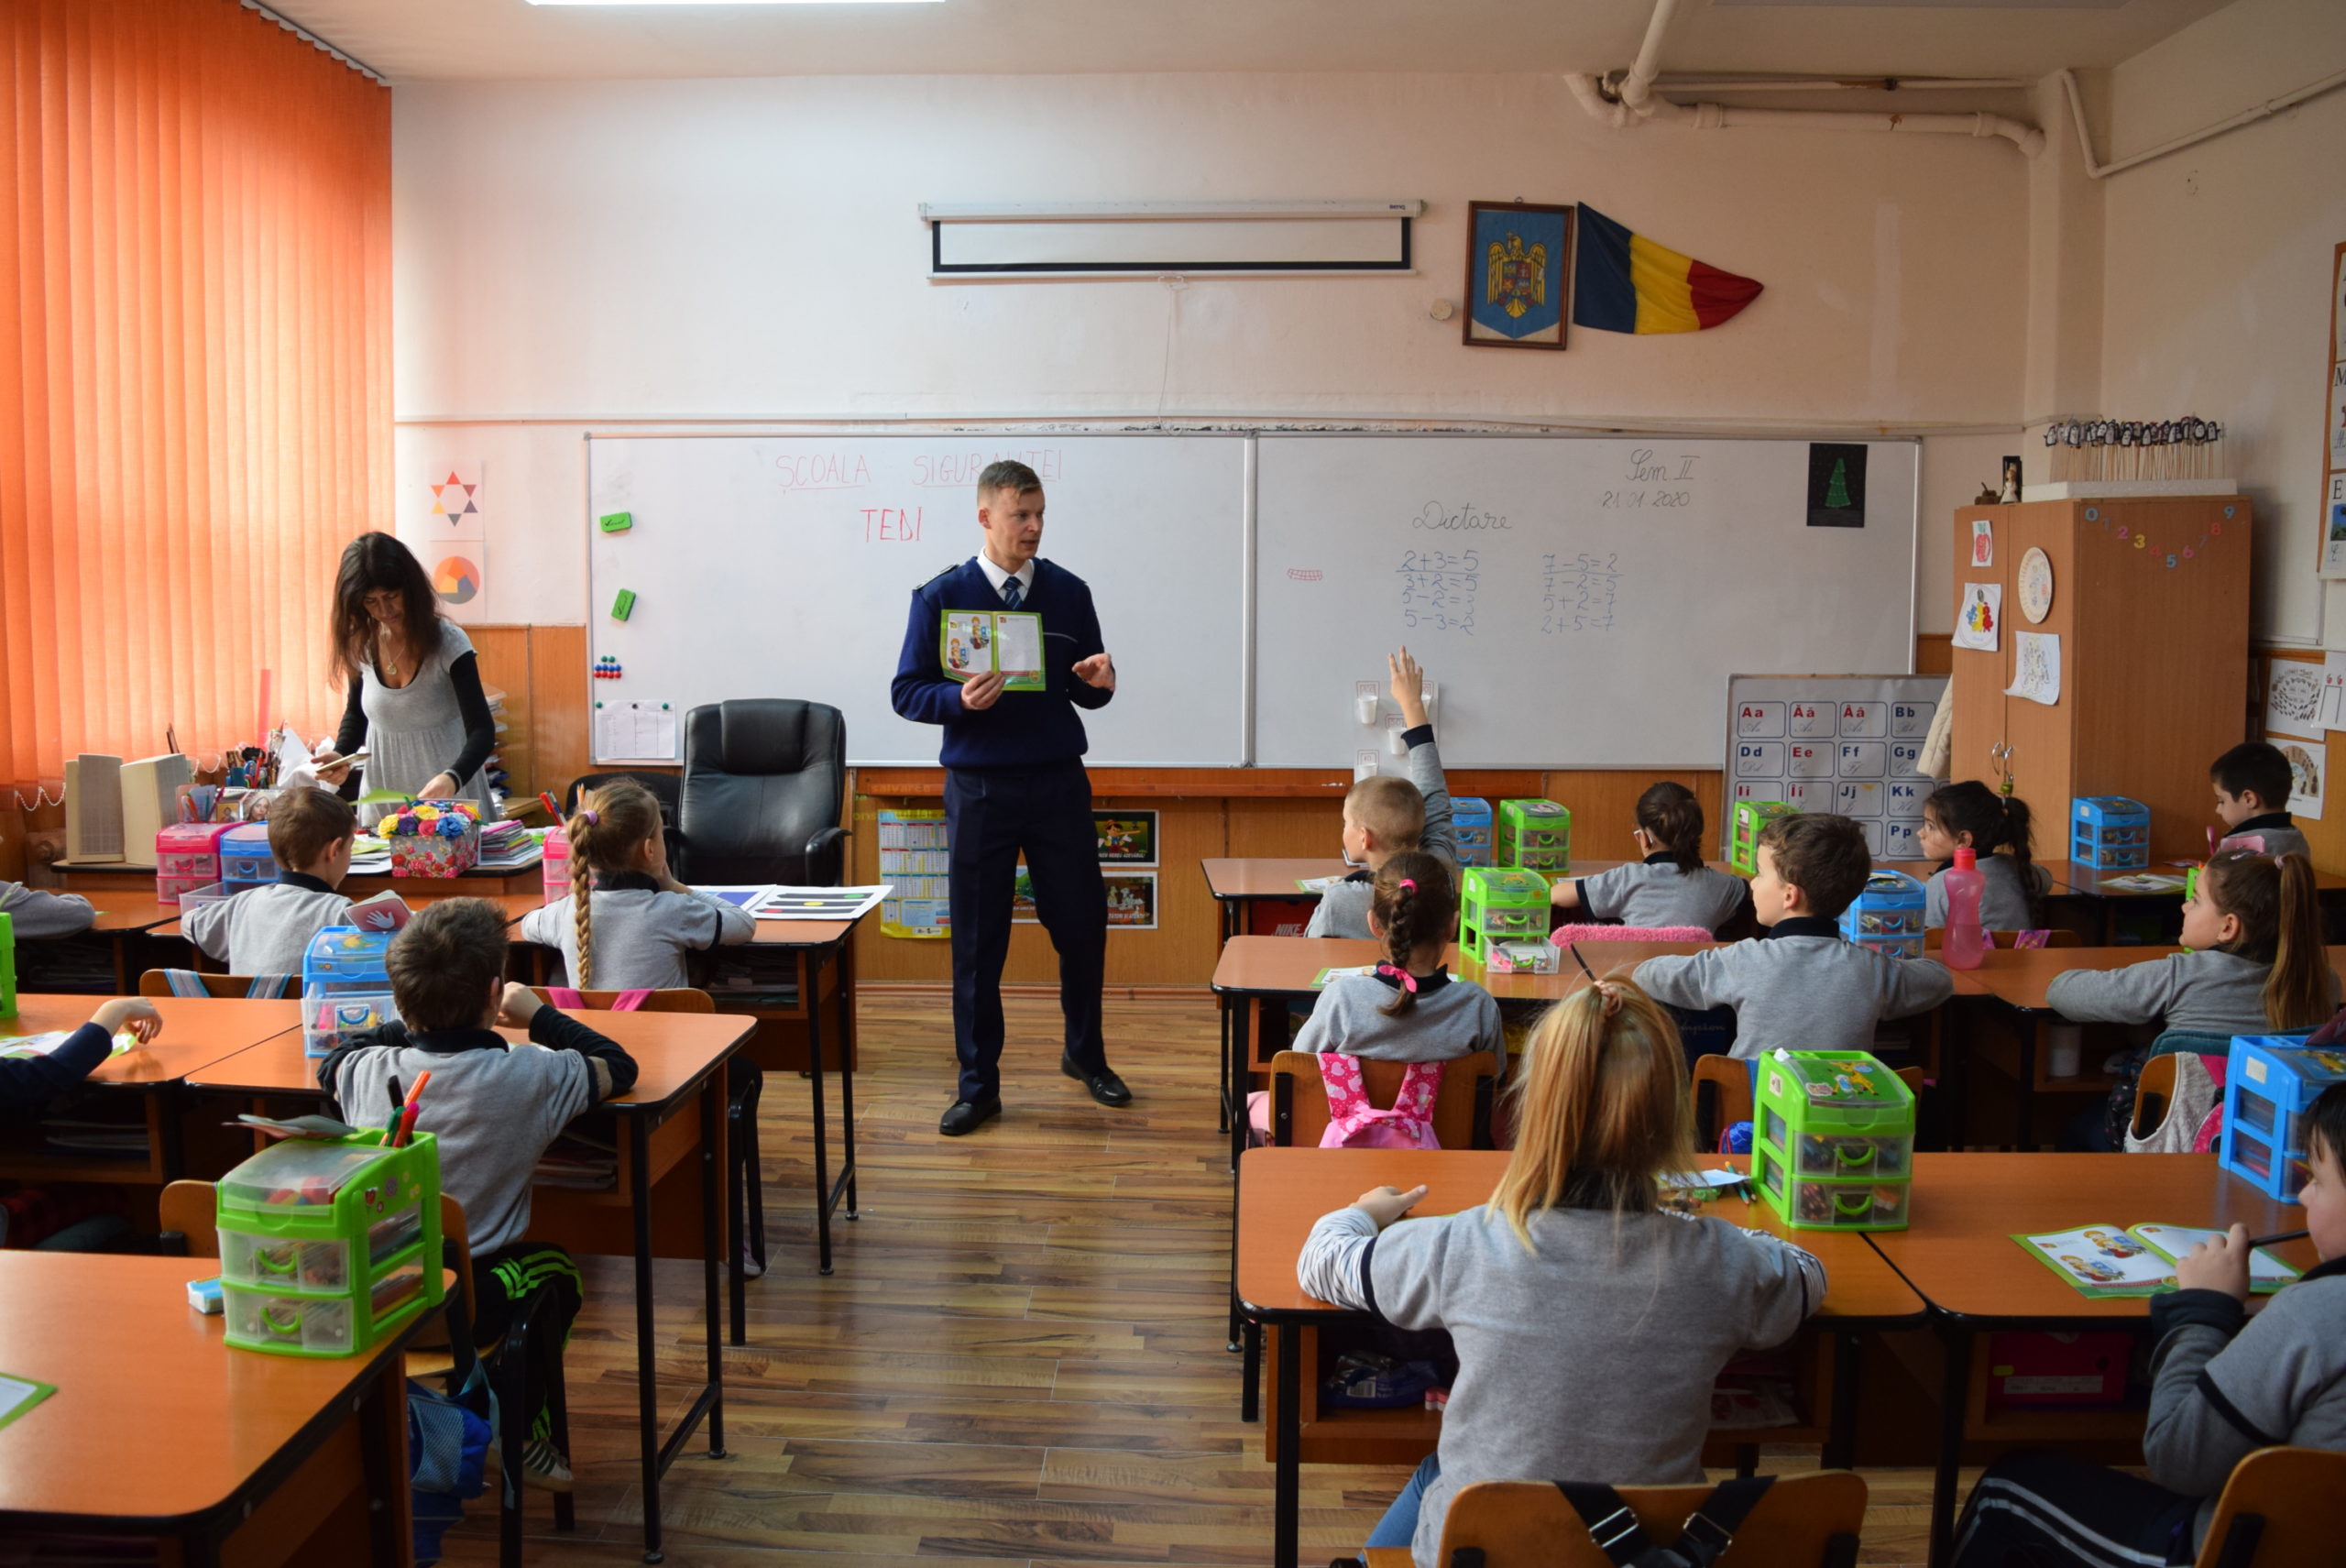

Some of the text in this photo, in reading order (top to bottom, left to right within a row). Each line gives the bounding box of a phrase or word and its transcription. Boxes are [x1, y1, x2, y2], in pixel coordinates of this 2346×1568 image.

[859, 506, 922, 543] TEDI
[1411, 500, 1513, 531] Dictare
[2085, 508, 2099, 521] 0
[2118, 526, 2129, 540] 2
[2133, 534, 2146, 549] 3
[2149, 545, 2162, 556] 4
[2165, 554, 2177, 569] 5
[2183, 545, 2195, 559] 6
[2210, 522, 2221, 536] 8
[2223, 505, 2235, 520] 9
[1274, 924, 1302, 938] NIKE
